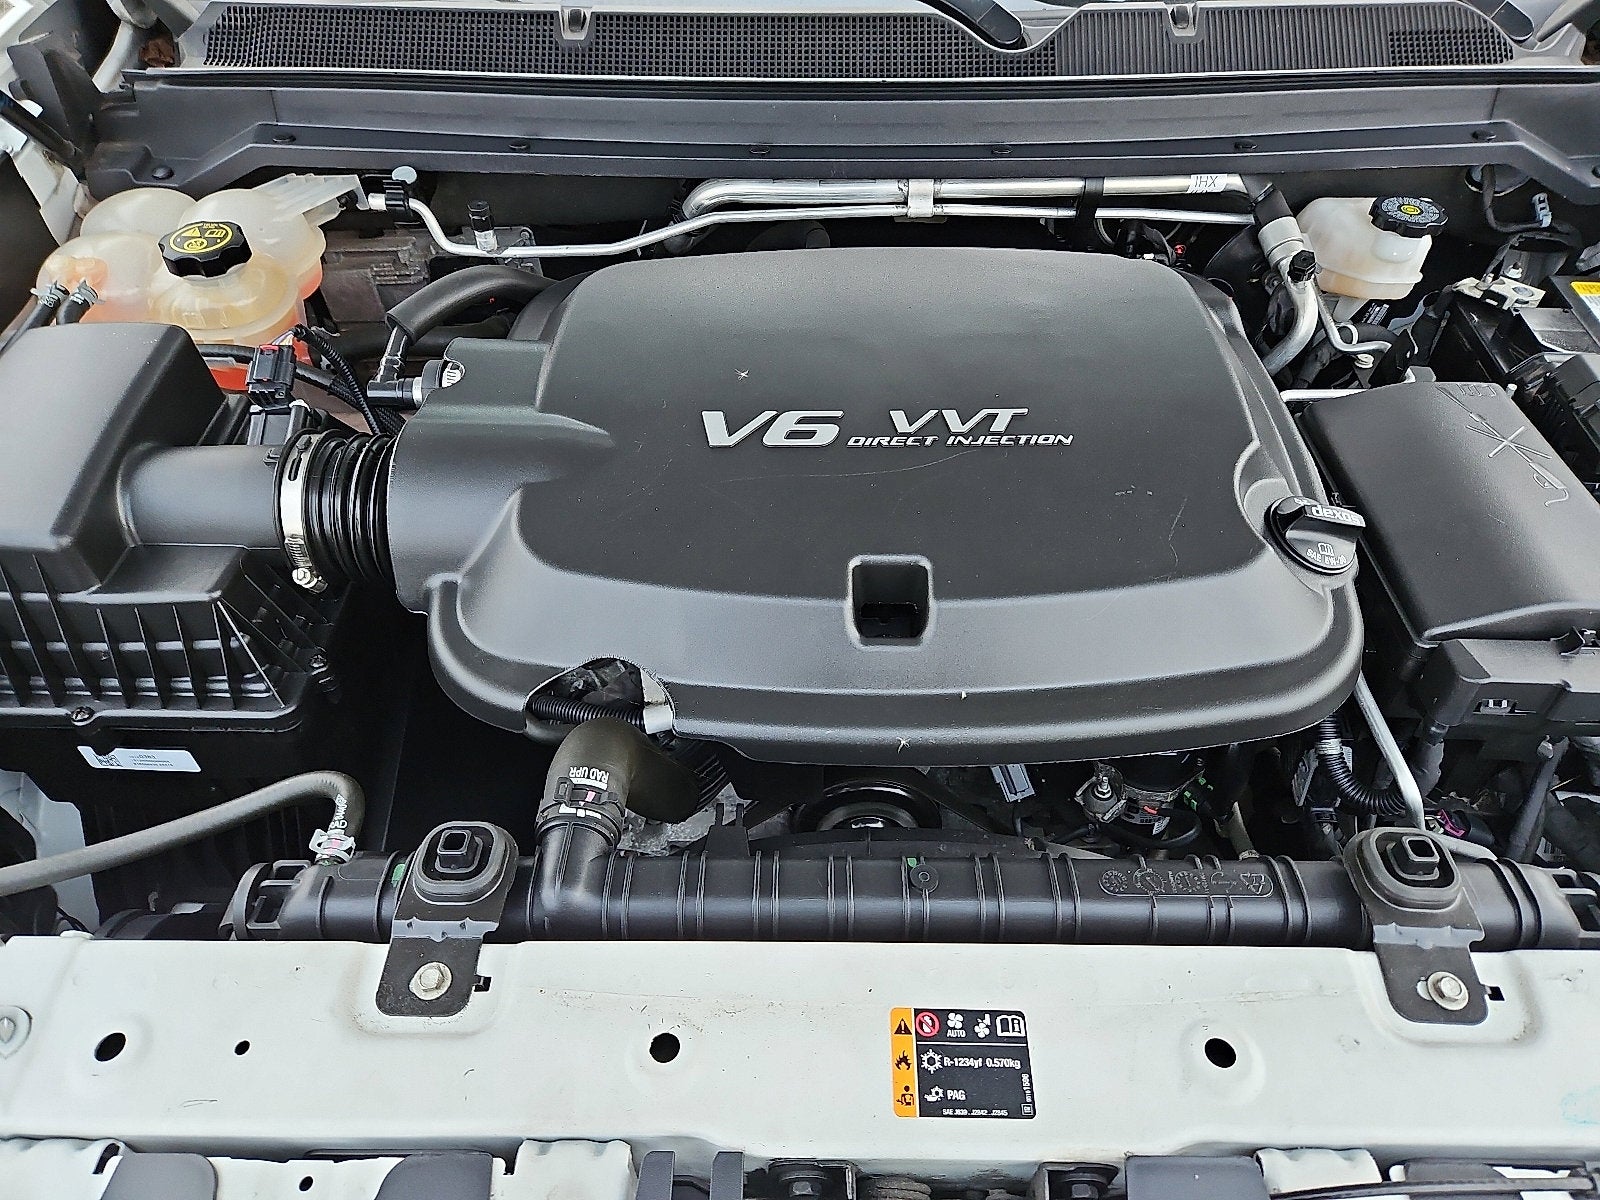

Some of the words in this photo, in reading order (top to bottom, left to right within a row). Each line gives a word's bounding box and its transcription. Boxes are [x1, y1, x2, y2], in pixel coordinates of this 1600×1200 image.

[701, 409, 845, 448] V6
[889, 407, 1029, 434] VVT
[846, 435, 939, 448] DIRECT
[945, 434, 1074, 447] INJECTION
[1311, 504, 1362, 526] dexos
[569, 766, 589, 779] UPR
[589, 767, 609, 784] RAD
[946, 1029, 967, 1038] AUTO
[943, 1057, 983, 1069] R-1234yf
[985, 1058, 1021, 1070] 0.570kg
[946, 1089, 966, 1101] PAG
